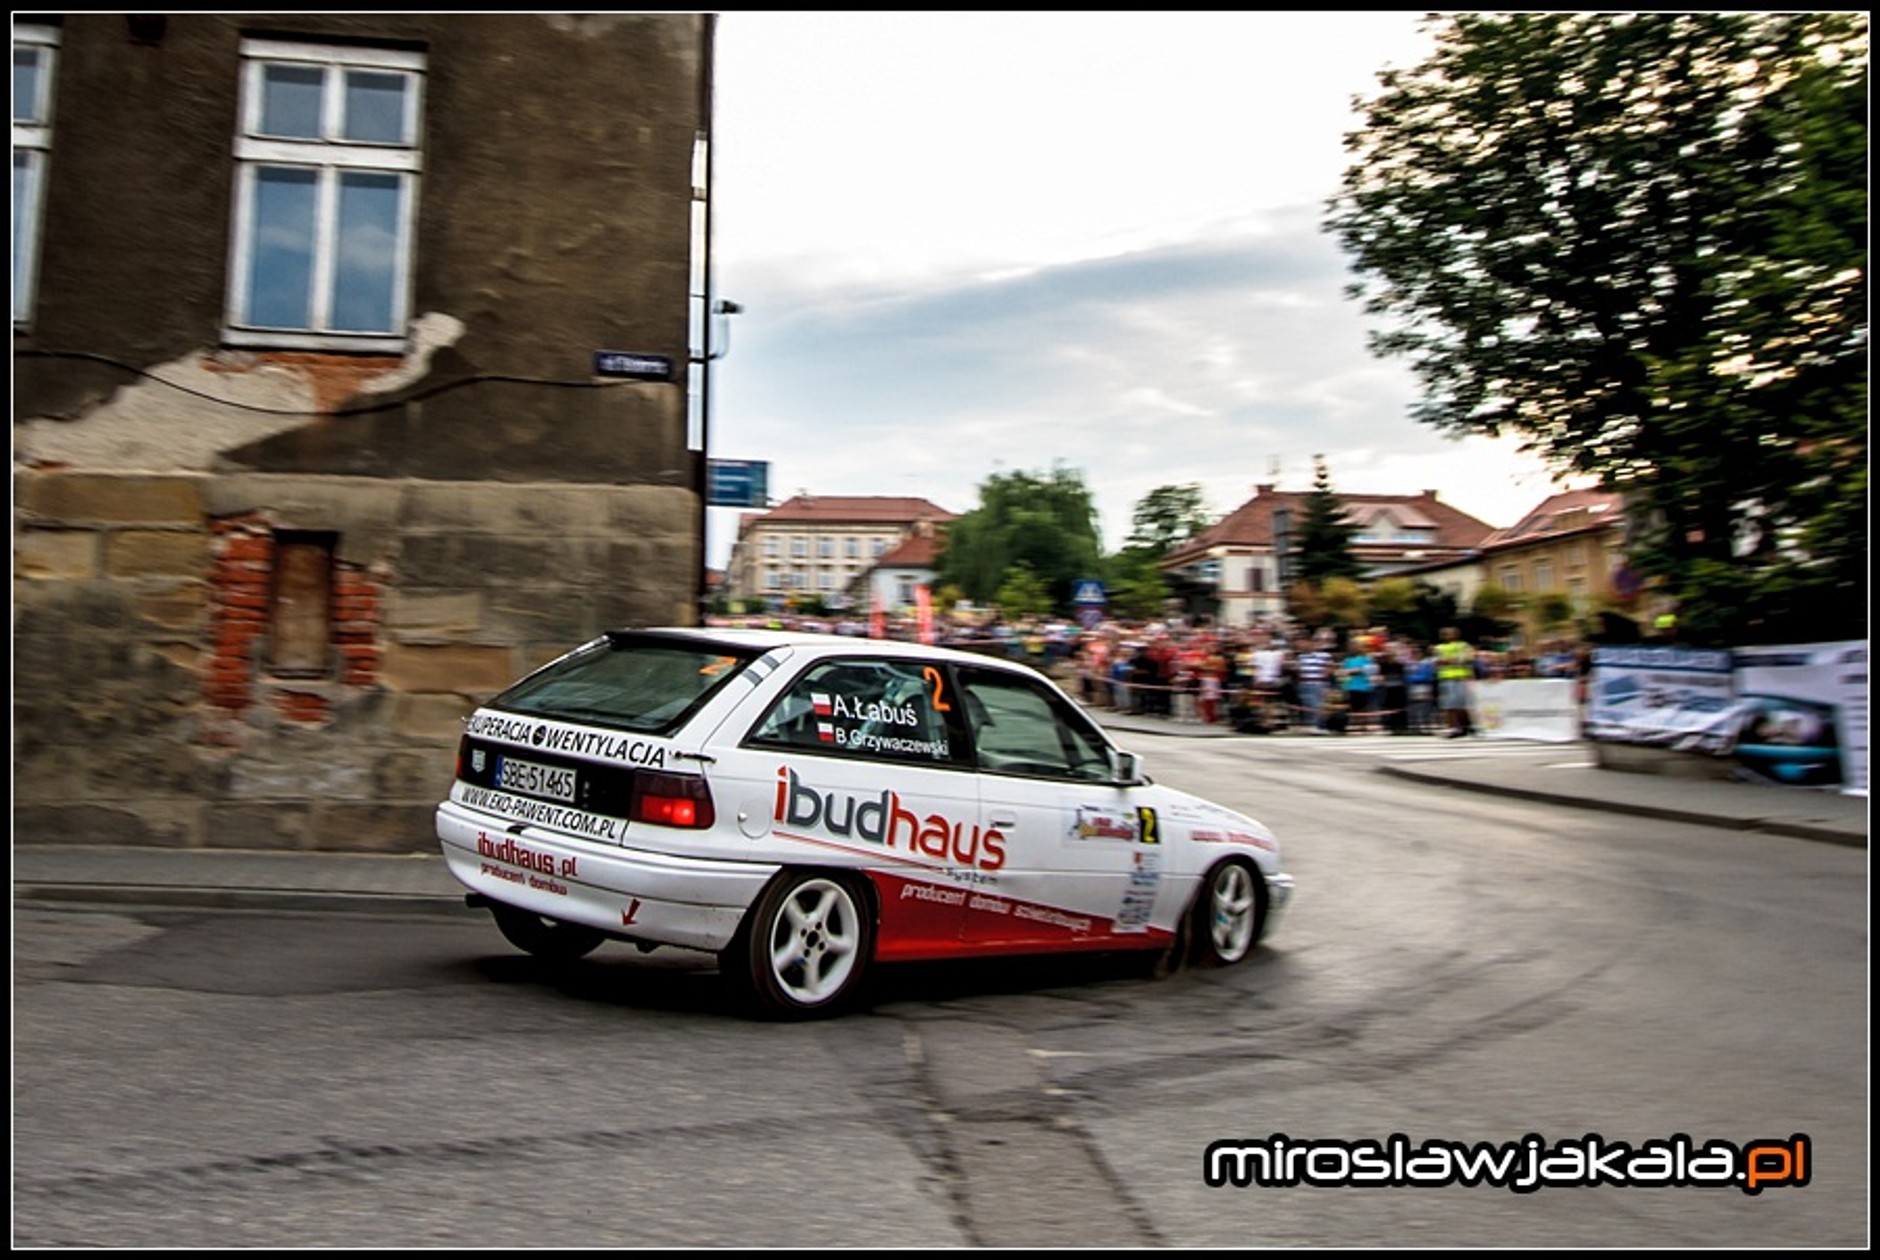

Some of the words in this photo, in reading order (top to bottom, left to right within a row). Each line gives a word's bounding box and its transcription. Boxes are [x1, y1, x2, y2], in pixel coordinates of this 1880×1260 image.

[922, 665, 951, 712] 2
[833, 693, 919, 727] A.Łabuś
[545, 728, 665, 769] WENTYLACJA
[502, 760, 526, 789] SBE
[528, 765, 575, 798] 51465
[462, 786, 617, 839] WWW.EKO-PAWENT.COM.PL
[774, 765, 1007, 871] ibudhaus
[1139, 807, 1157, 844] 2
